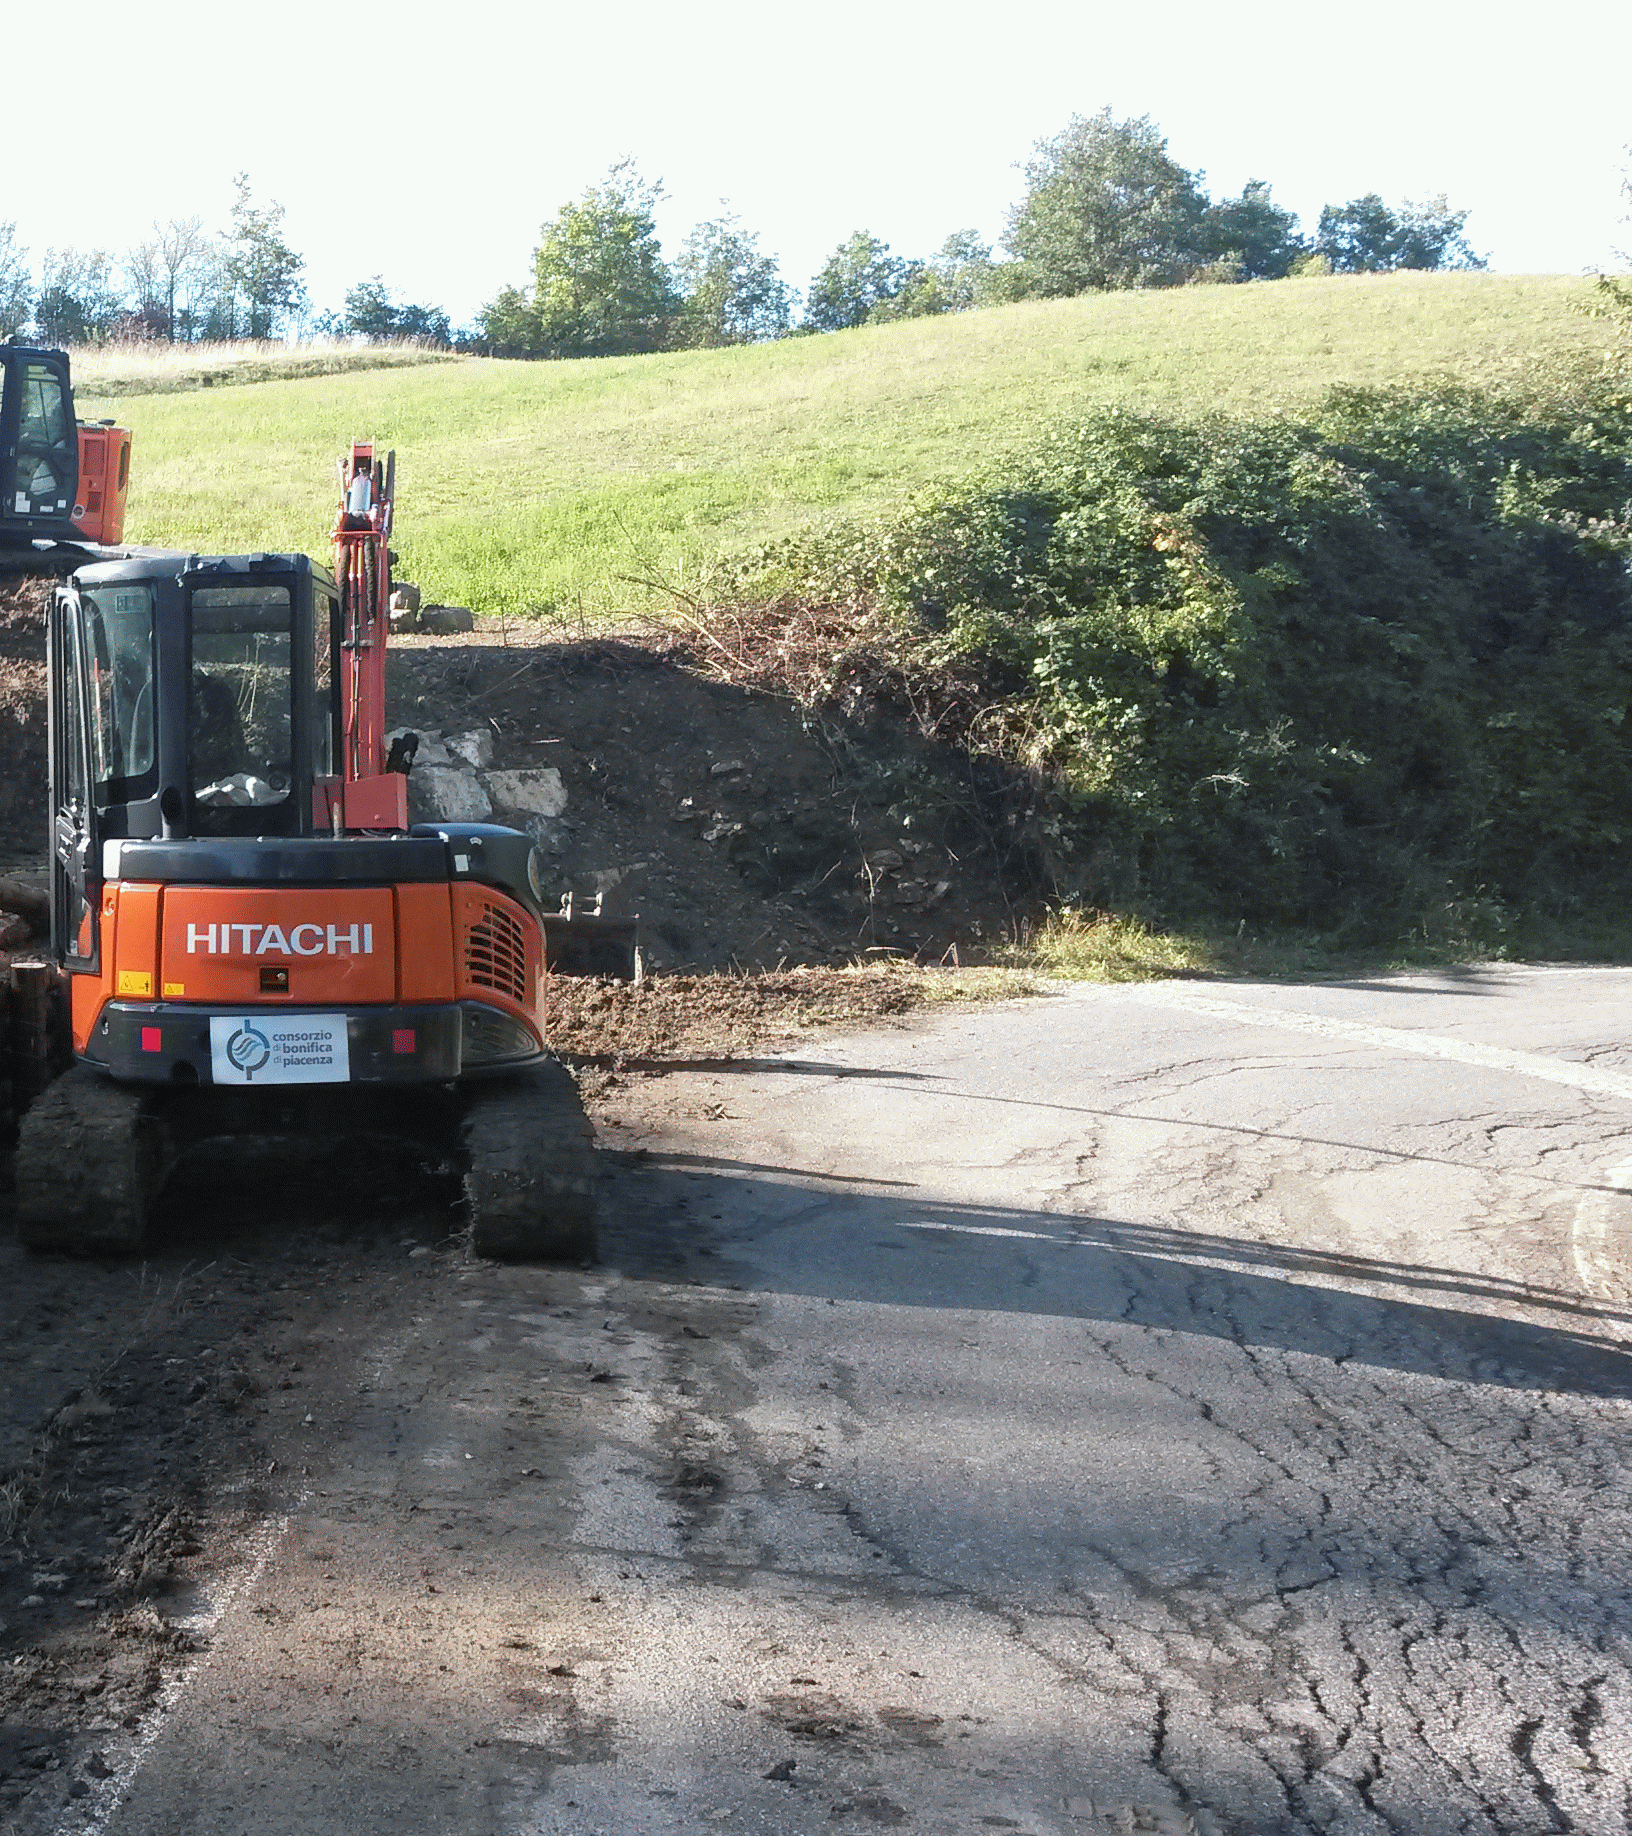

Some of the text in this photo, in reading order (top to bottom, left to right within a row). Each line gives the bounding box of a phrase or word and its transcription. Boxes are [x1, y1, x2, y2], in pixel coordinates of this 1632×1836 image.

[187, 923, 373, 955] HITACHI
[273, 1030, 333, 1042] consorzio
[273, 1042, 333, 1054] di bonifica
[274, 1055, 333, 1068] di piacenza
